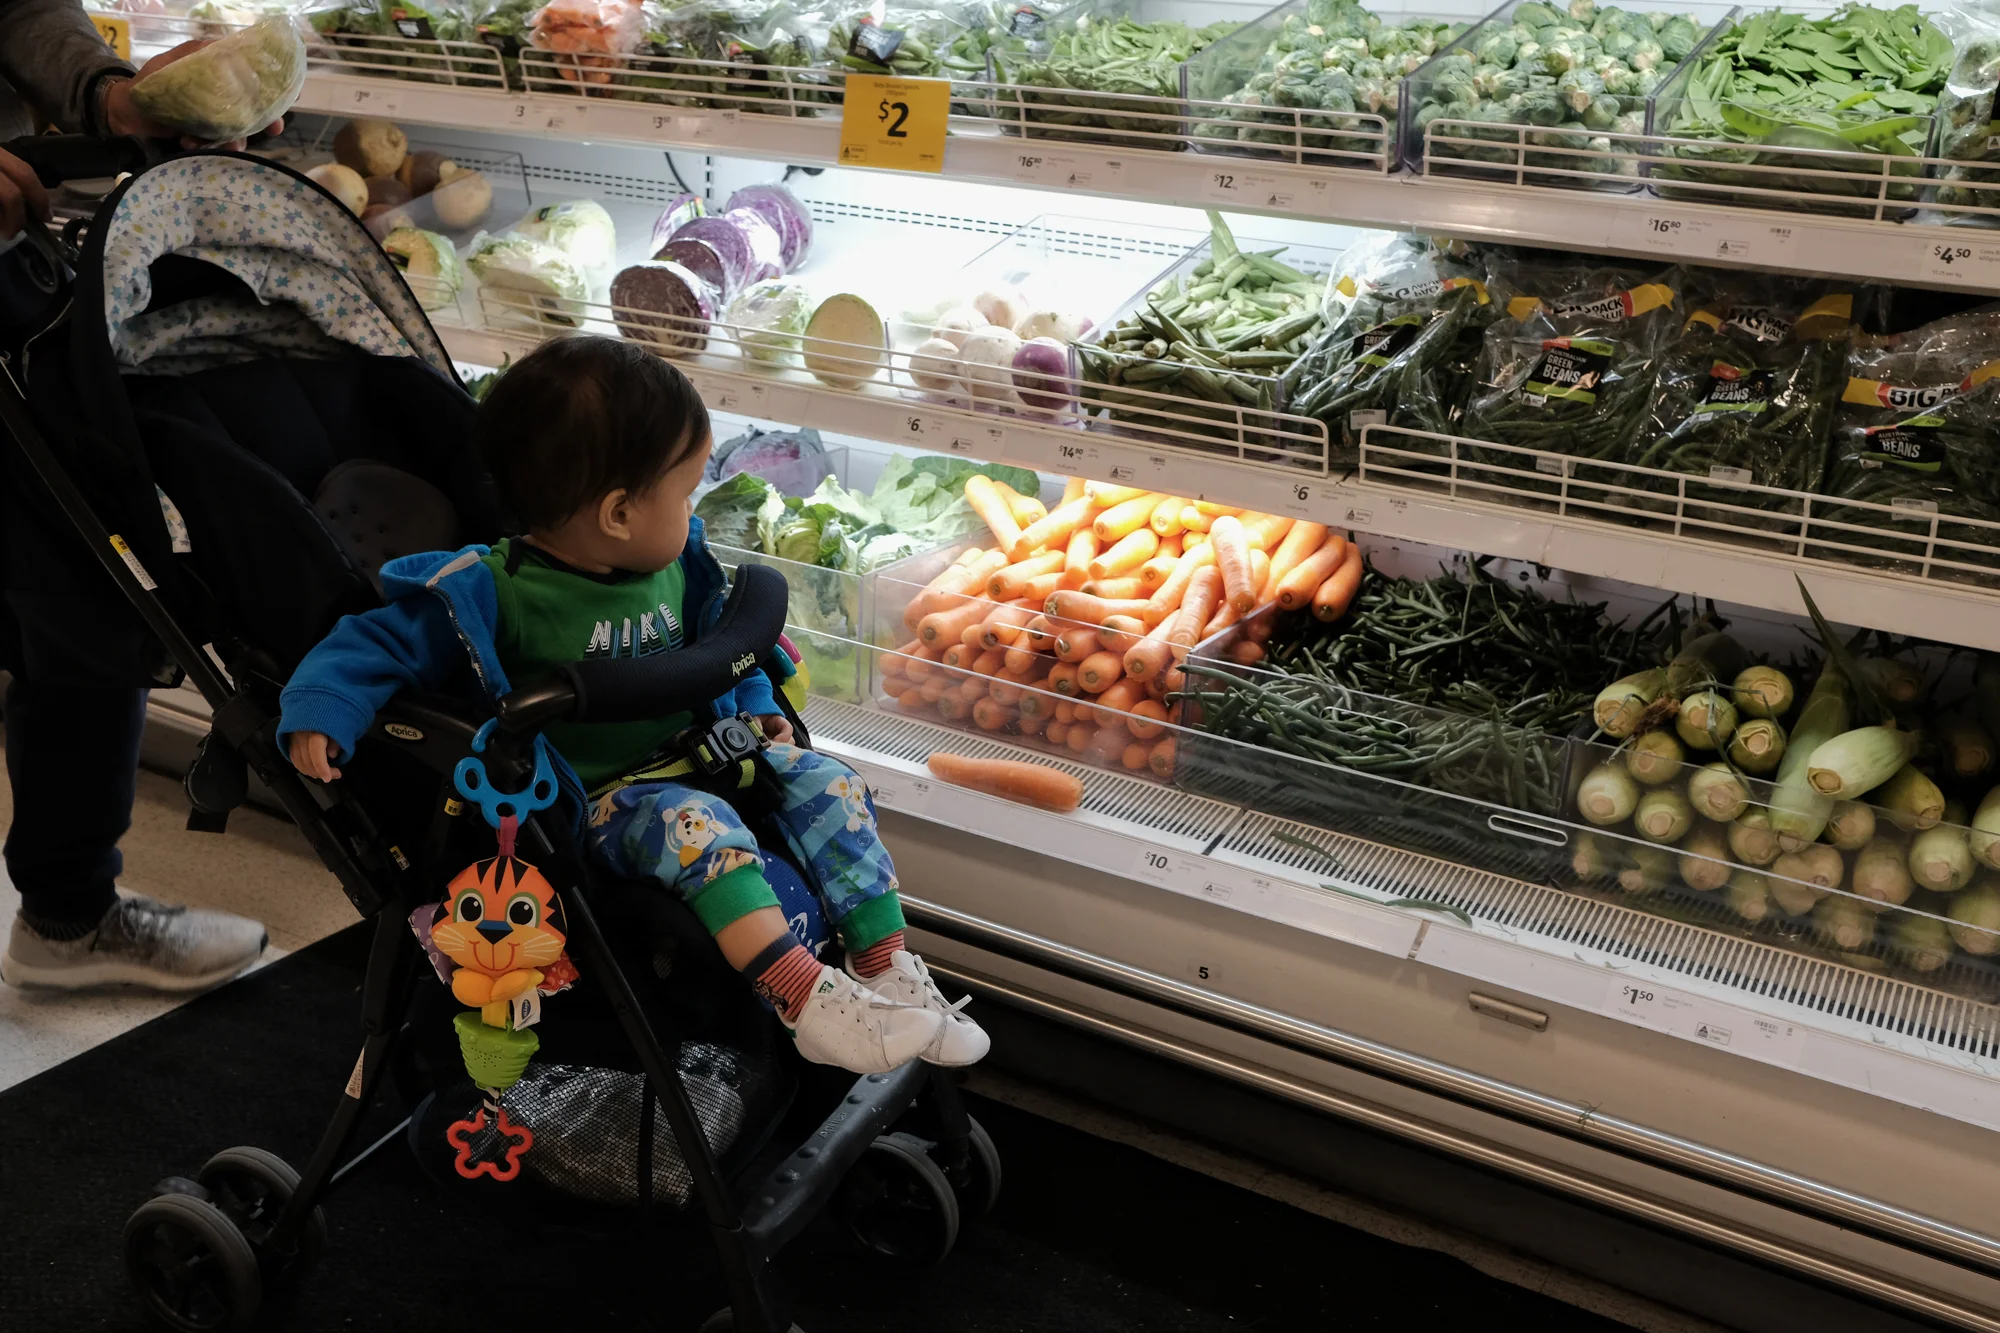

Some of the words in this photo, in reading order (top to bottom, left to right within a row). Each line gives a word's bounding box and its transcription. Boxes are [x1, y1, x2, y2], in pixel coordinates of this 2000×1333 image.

[102, 26, 118, 49] $2
[878, 98, 909, 137] $2
[1214, 174, 1234, 189] $12
[1592, 297, 1623, 315] PACK
[1547, 354, 1574, 370] GREEN
[1543, 364, 1581, 383] BEANS
[1711, 387, 1750, 401] BEANS
[907, 417, 920, 431] $6
[1882, 440, 1922, 459] BEANS
[1293, 484, 1310, 500] $6
[585, 603, 684, 656] NIKE
[731, 651, 756, 677] Aprica
[390, 725, 418, 739] Aprica
[1145, 852, 1168, 869] $10
[1198, 966, 1210, 980] 5
